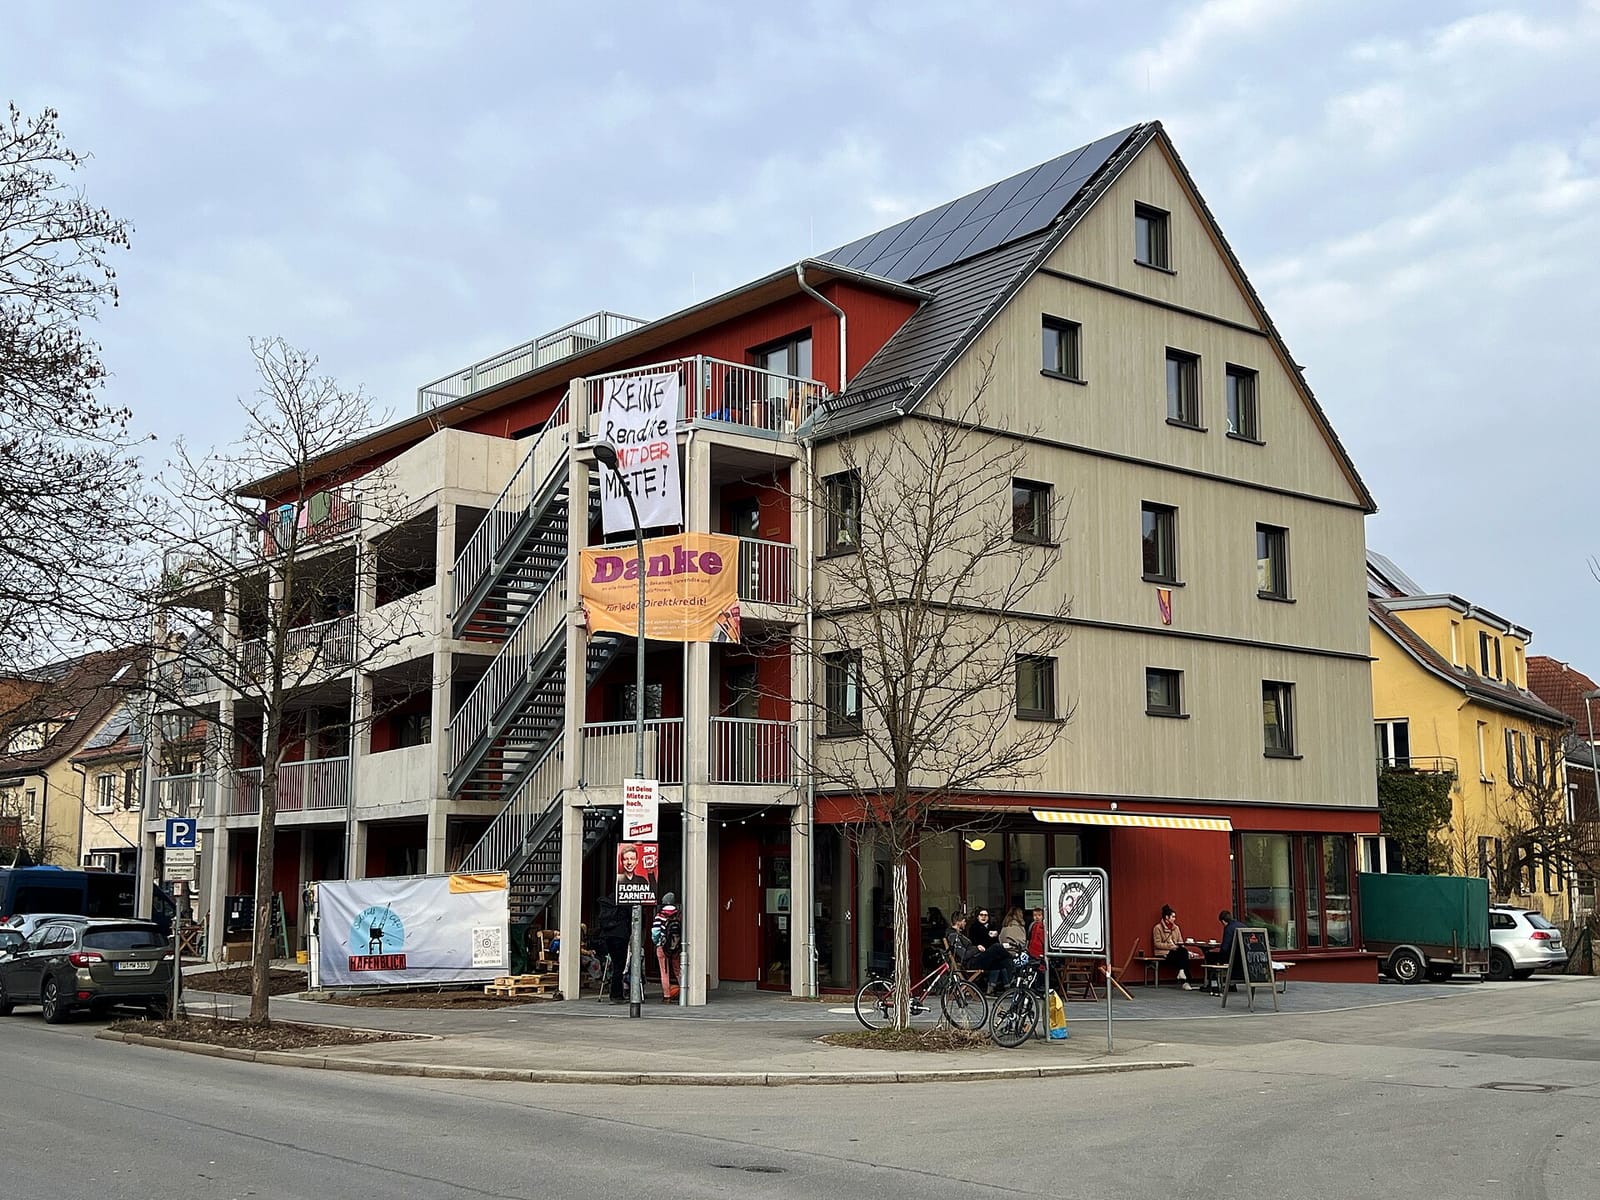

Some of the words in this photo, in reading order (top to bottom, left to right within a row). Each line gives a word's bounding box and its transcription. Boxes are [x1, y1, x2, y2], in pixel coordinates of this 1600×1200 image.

[591, 545, 722, 583] Danke
[644, 597, 707, 607] Direktkredit!
[172, 822, 190, 845] P
[618, 884, 650, 892] FLORIAN
[618, 892, 656, 900] ZARNETTA
[1063, 932, 1090, 945] ZONE
